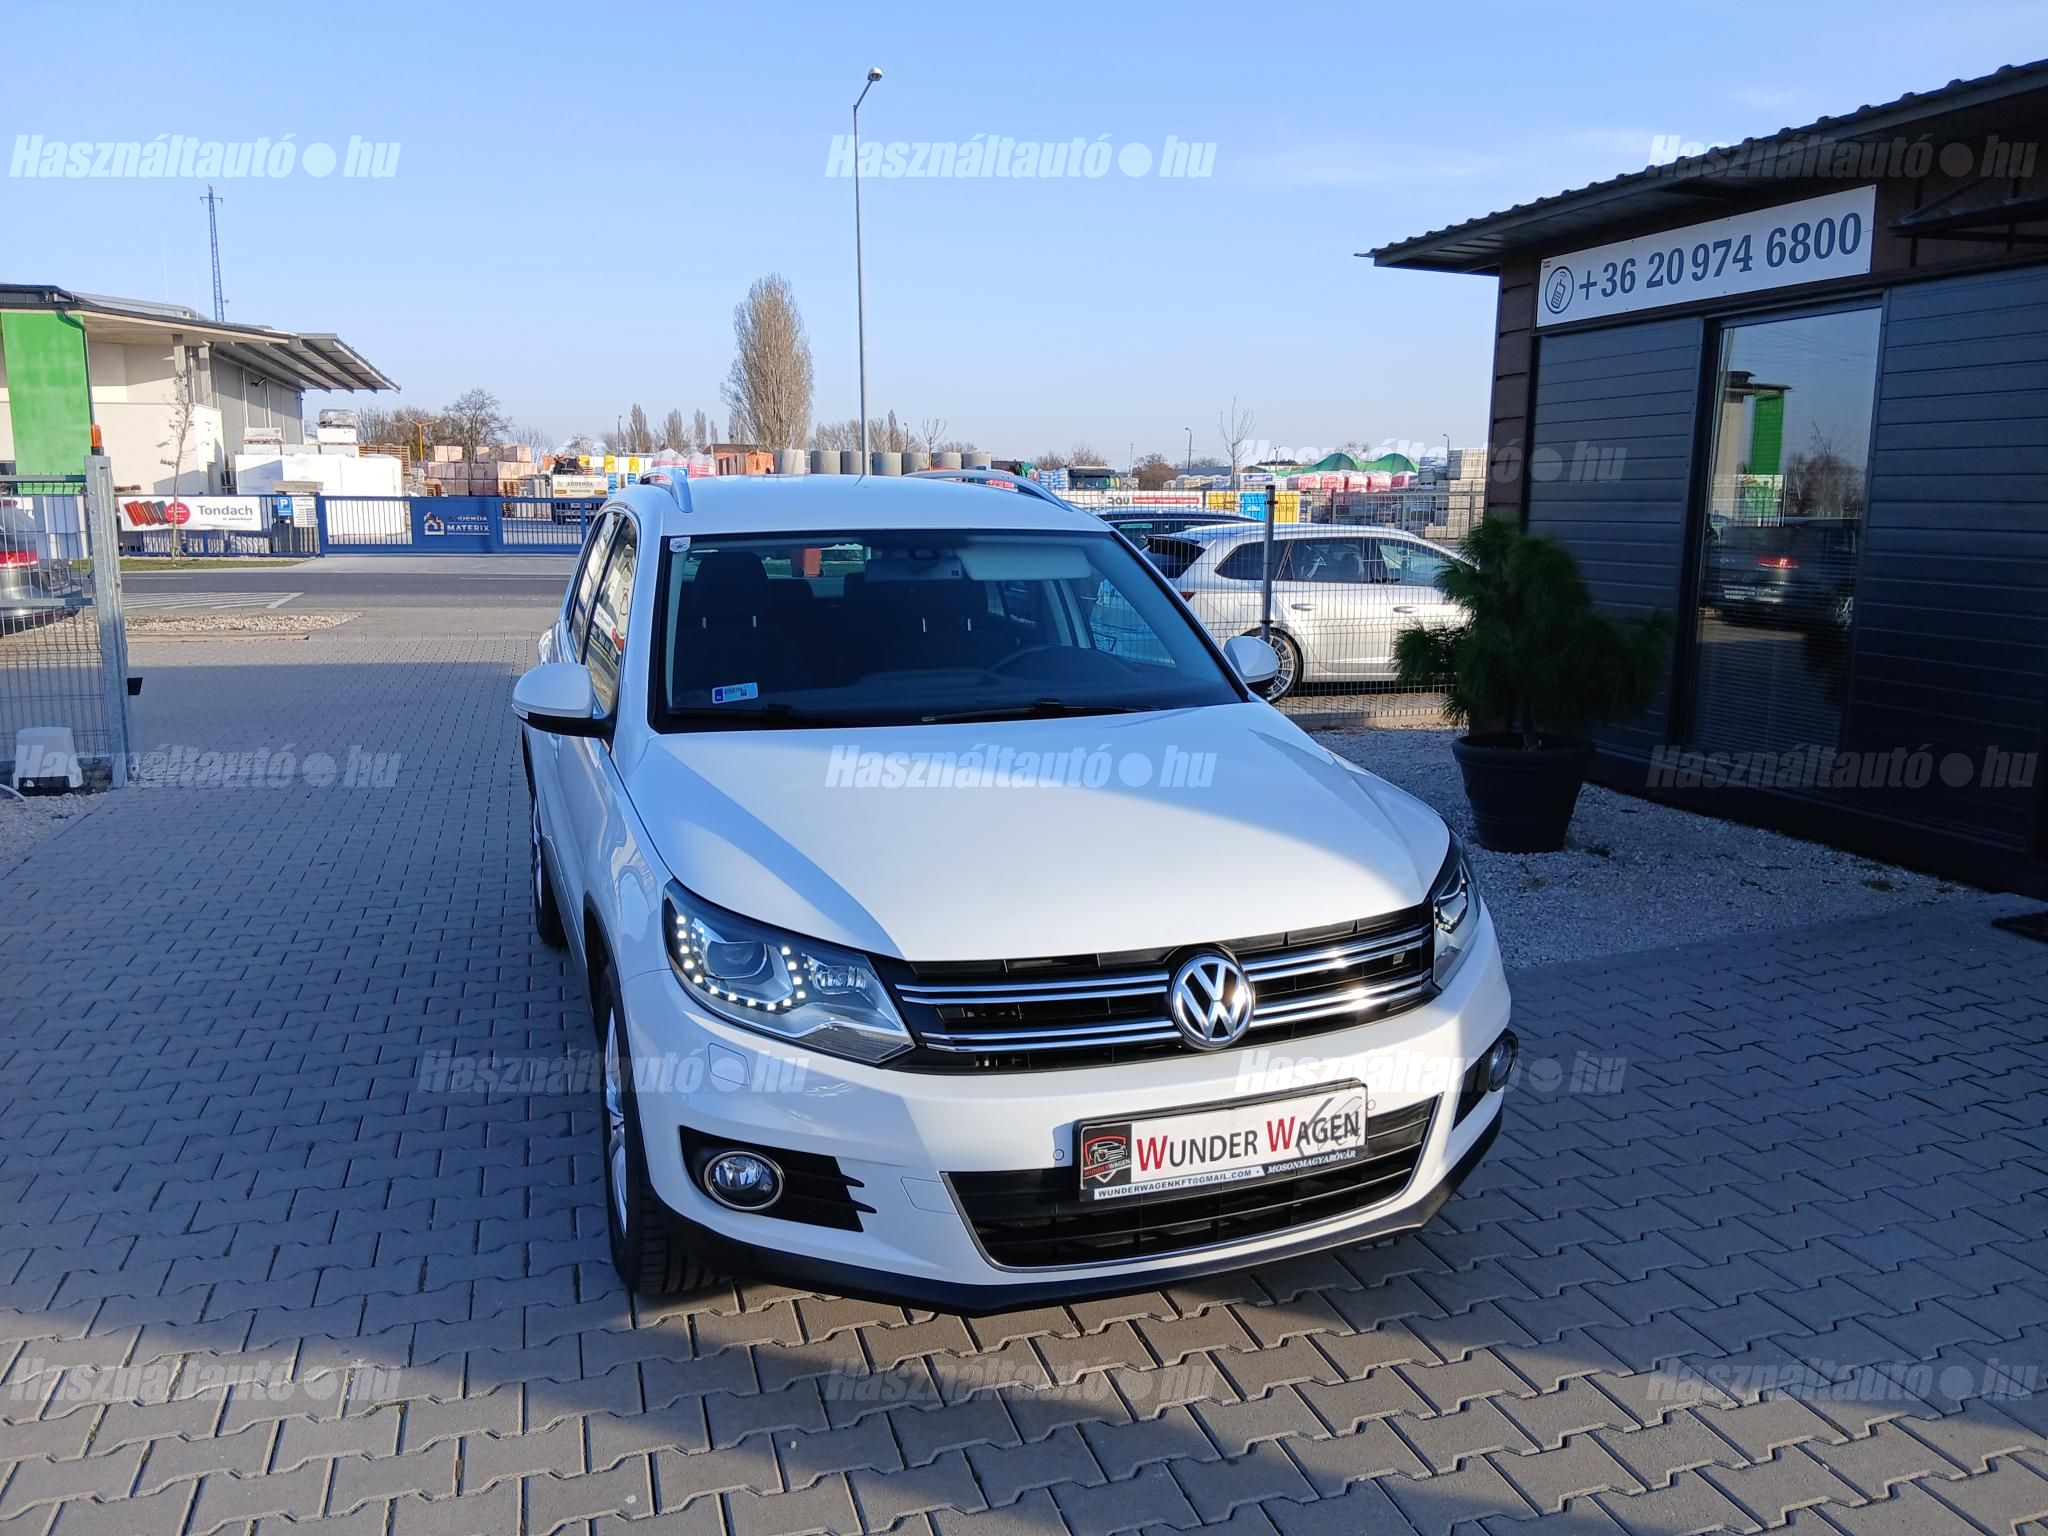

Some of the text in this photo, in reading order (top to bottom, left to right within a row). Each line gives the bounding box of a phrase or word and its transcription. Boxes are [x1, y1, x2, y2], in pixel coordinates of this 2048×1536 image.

[1579, 212, 1862, 300] +36 20 974 6800
[197, 505, 253, 515] Tondach
[1136, 1111, 1361, 1172] WUNDER WAGEN
[1266, 1149, 1357, 1174] MOSONMAGYARÓVÁR
